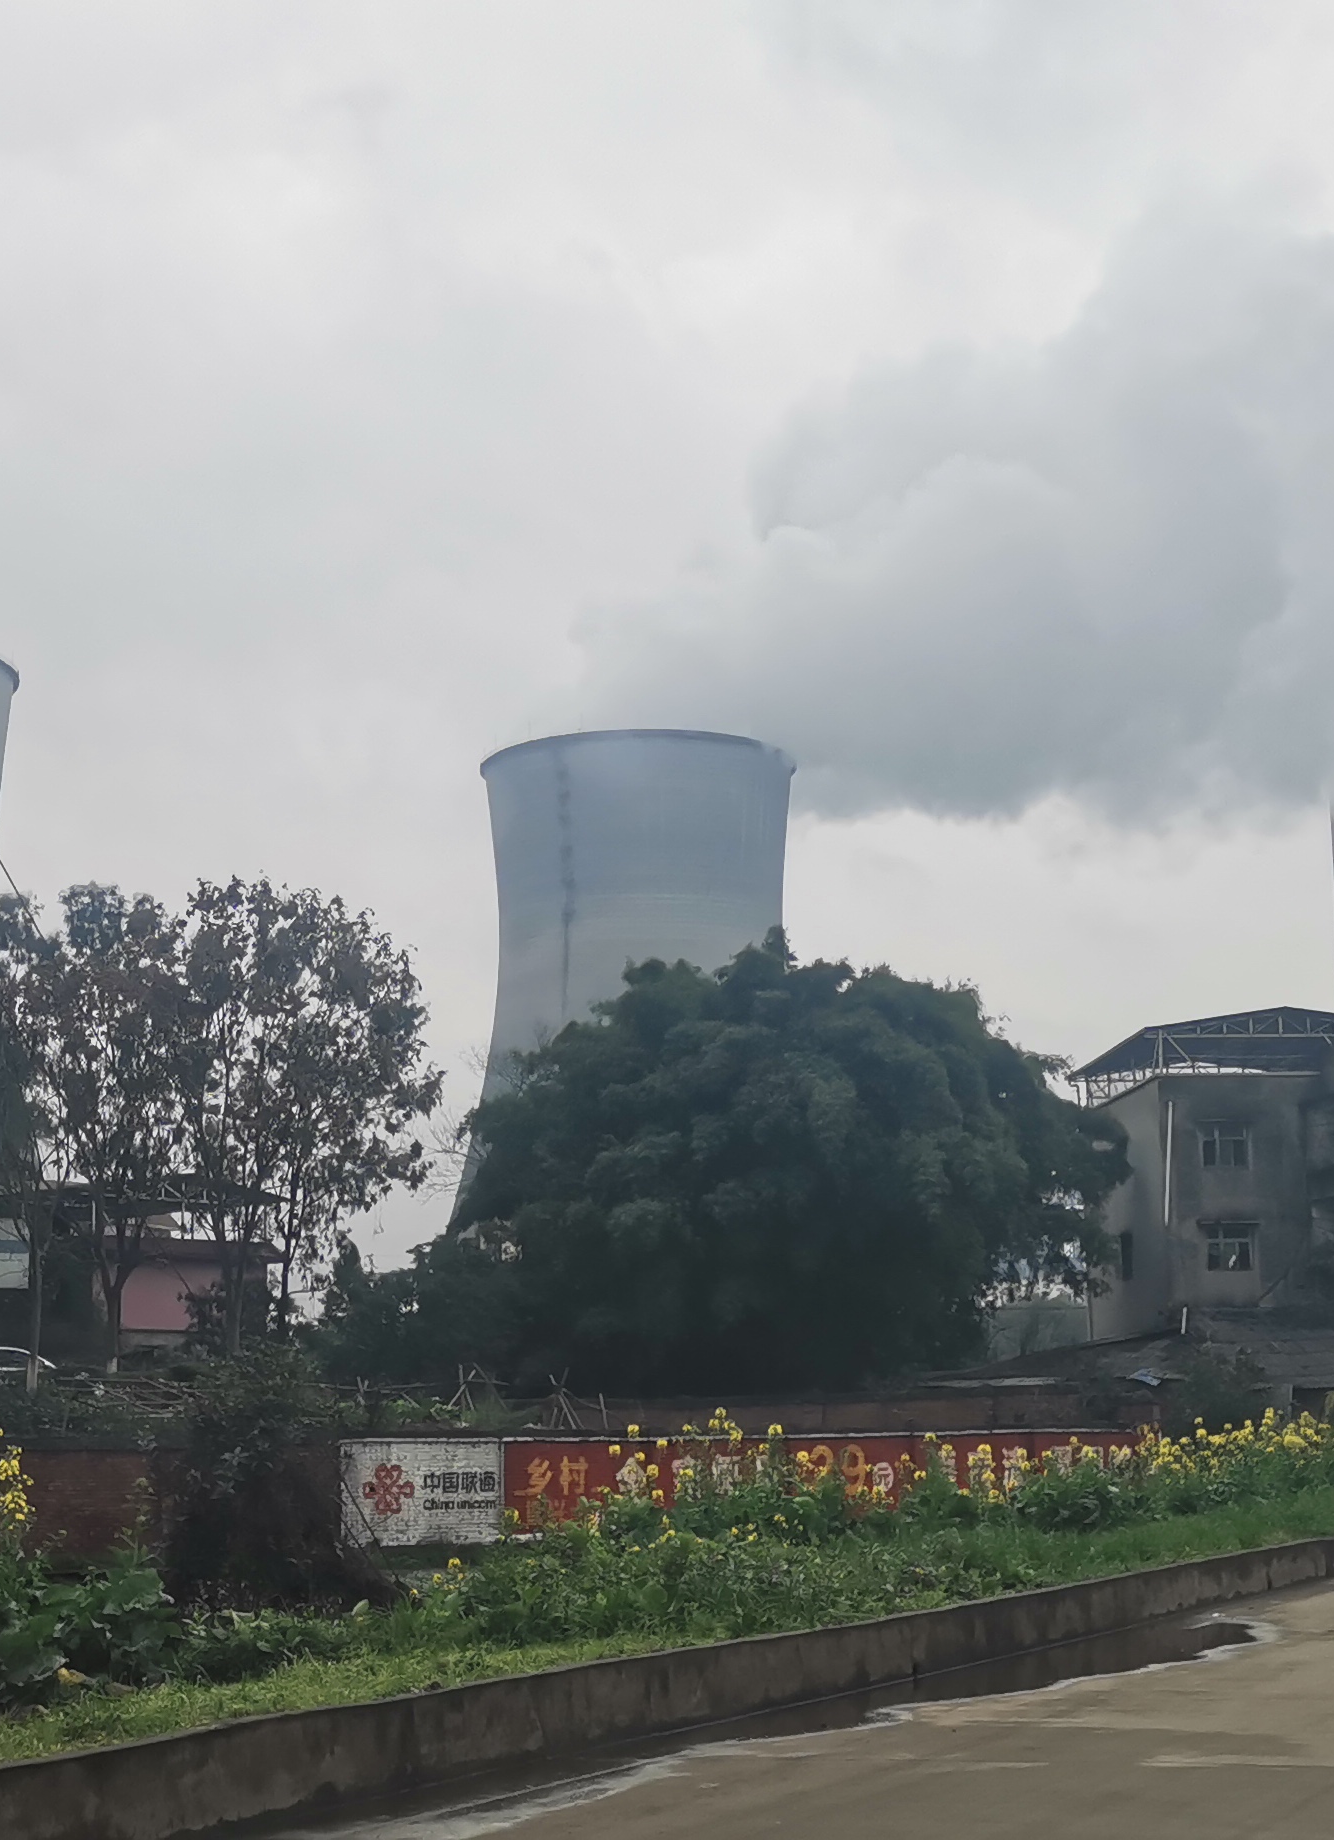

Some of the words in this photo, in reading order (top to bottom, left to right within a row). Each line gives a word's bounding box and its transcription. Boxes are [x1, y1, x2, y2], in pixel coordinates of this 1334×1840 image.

[423, 1471, 497, 1494] 中国联通
[514, 1456, 588, 1496] 乡村
[423, 1498, 455, 1511] China
